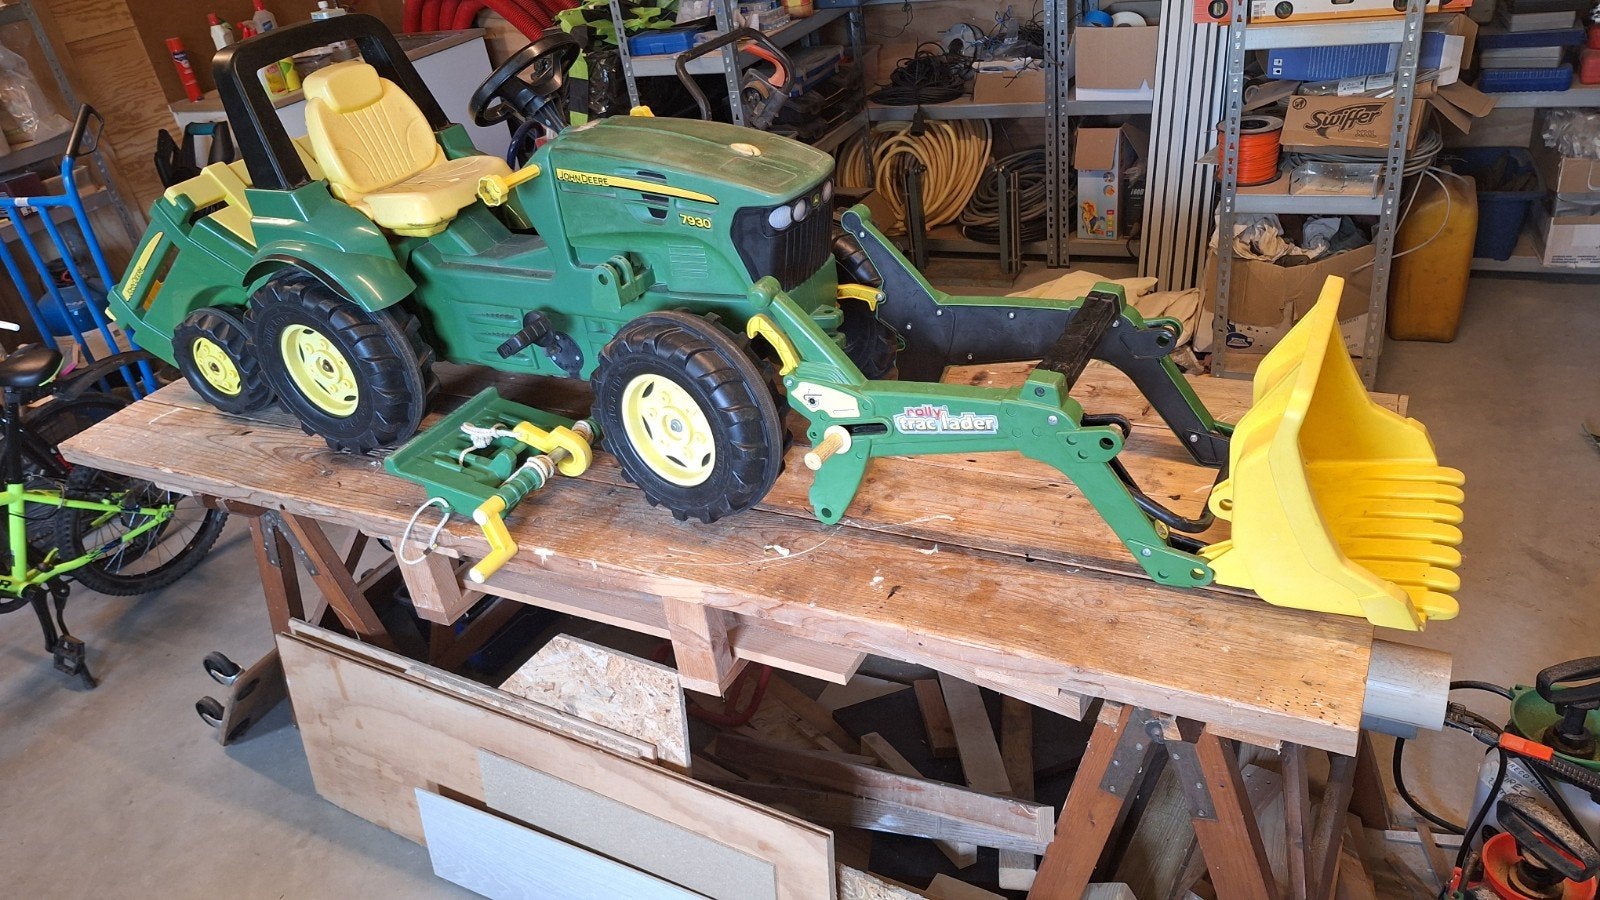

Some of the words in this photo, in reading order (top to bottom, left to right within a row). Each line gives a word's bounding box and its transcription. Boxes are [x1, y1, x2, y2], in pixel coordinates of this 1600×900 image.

[1304, 106, 1382, 131] Swiffer
[559, 171, 581, 181] JOHN
[581, 174, 609, 185] DEERE
[679, 213, 712, 229] 7930
[900, 416, 937, 431] trac
[940, 411, 994, 431] lader
[907, 406, 941, 420] rolly
